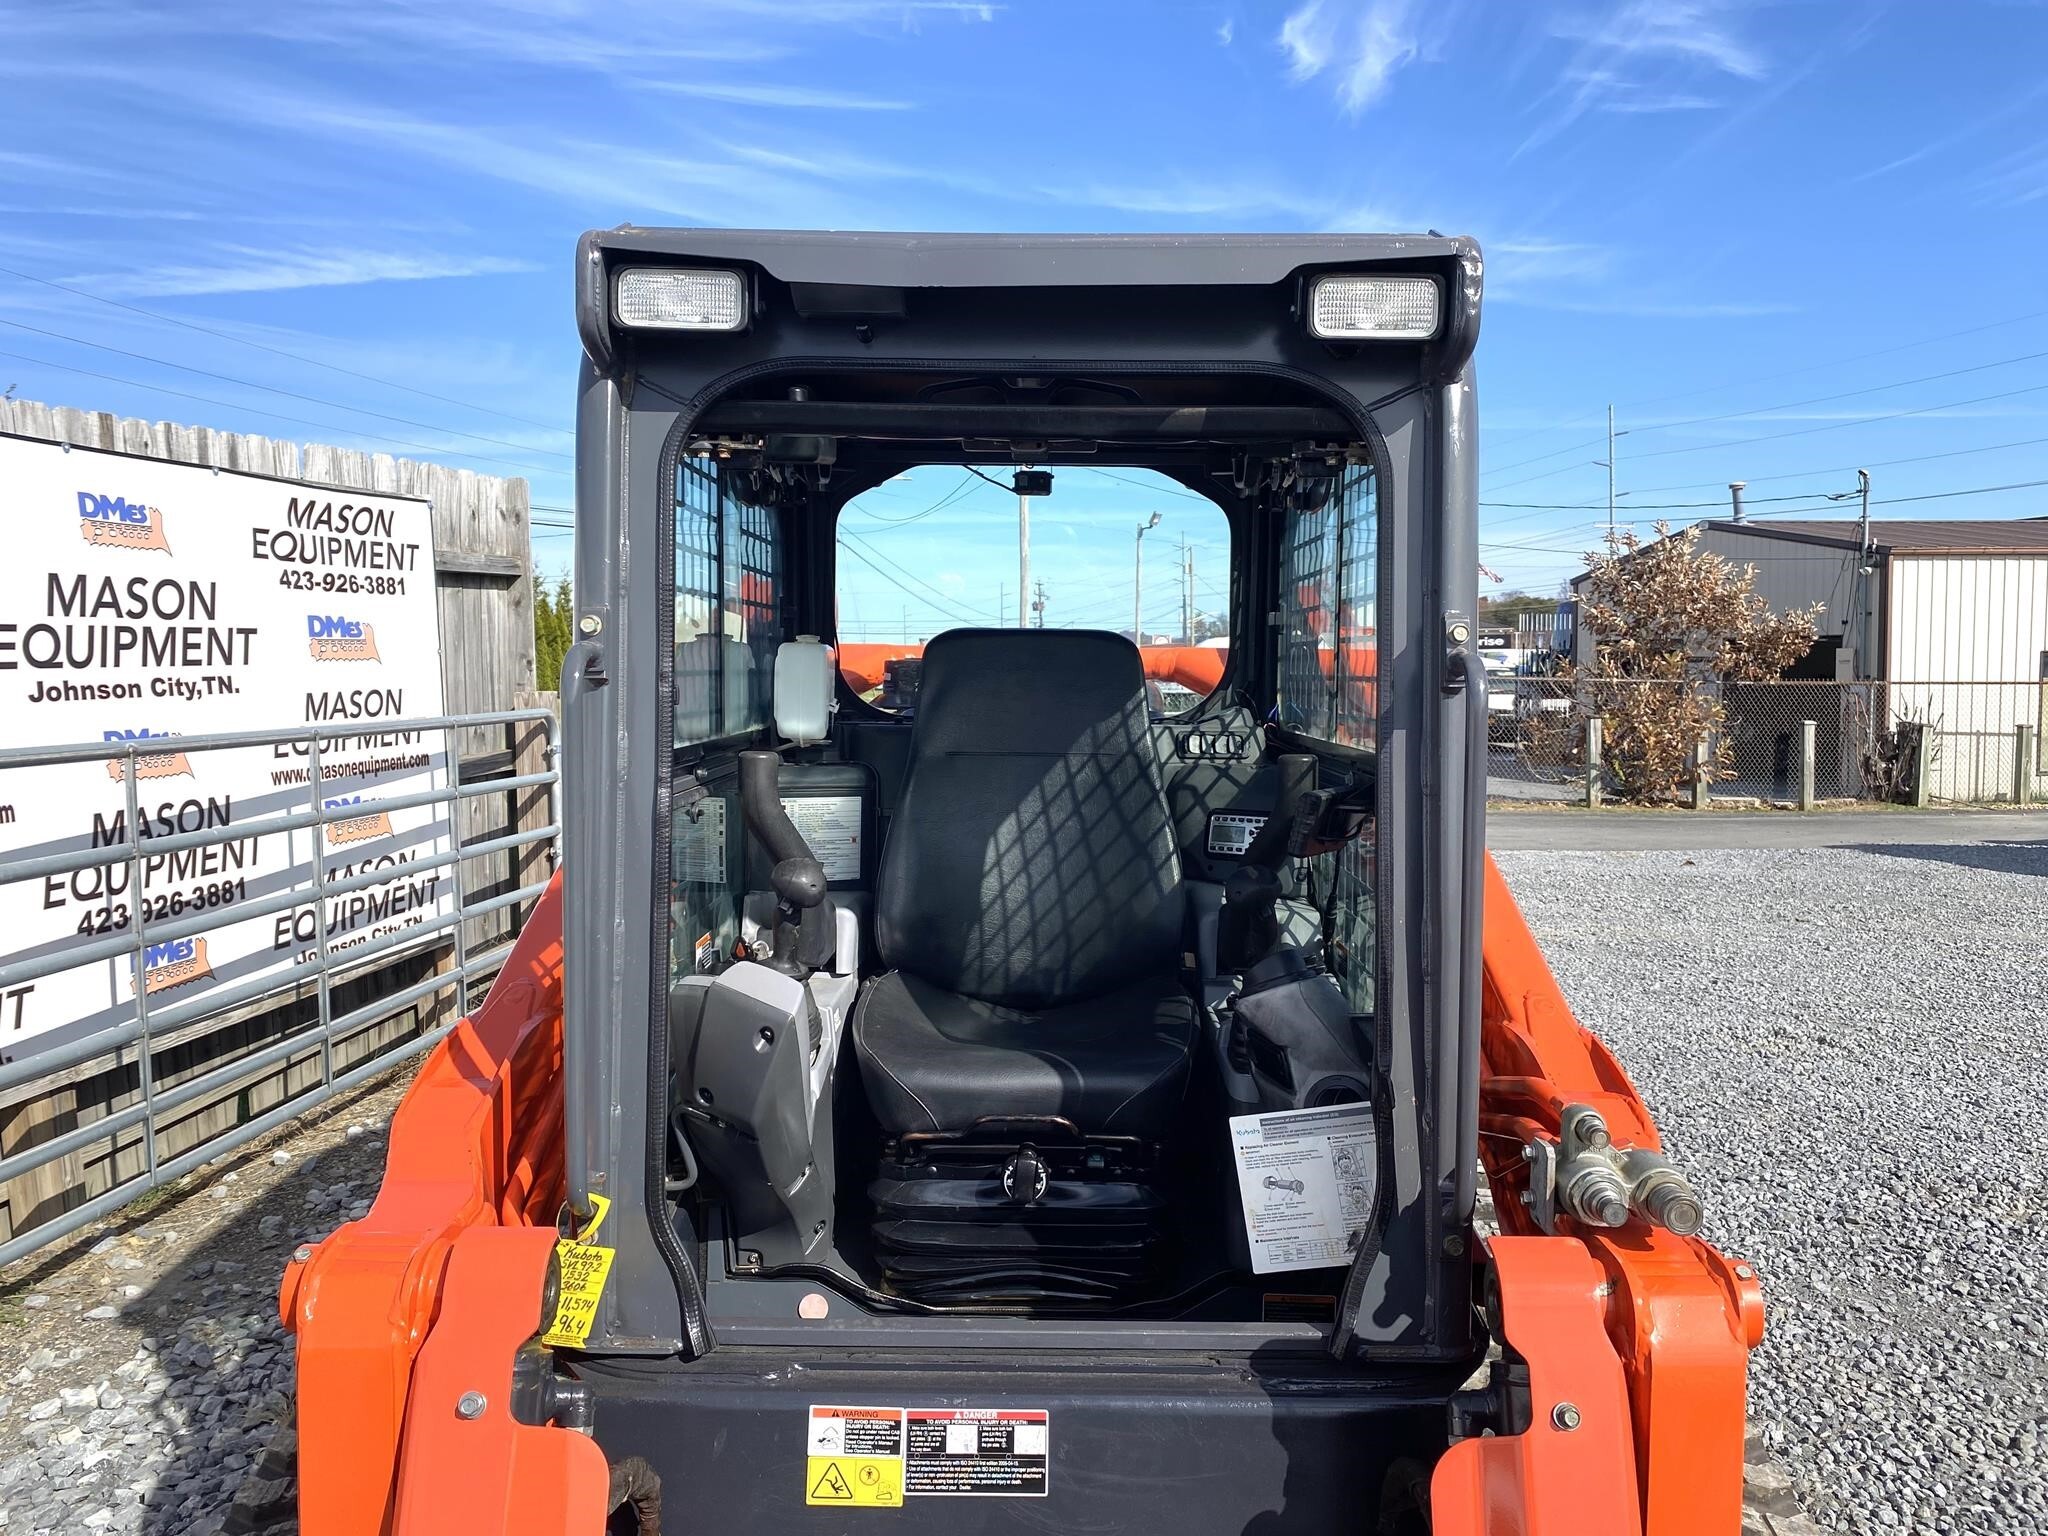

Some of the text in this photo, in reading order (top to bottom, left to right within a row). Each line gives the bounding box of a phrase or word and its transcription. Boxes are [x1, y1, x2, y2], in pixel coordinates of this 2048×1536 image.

[287, 497, 394, 538] MASON
[252, 527, 420, 571] EQUIPMENT
[46, 572, 216, 620] MASON
[279, 569, 406, 596] 423-926-3881
[28, 680, 142, 703] Johnson
[305, 688, 402, 722] MASON
[92, 795, 230, 849] MASON
[43, 836, 258, 910] EQUPMENT
[77, 877, 246, 937] 423-926-3881
[563, 1246, 603, 1262] Kubota
[560, 1281, 587, 1291] 3606
[562, 1270, 589, 1282] 1532
[841, 1410, 879, 1418] WARNING
[963, 1411, 998, 1419] DANGER
